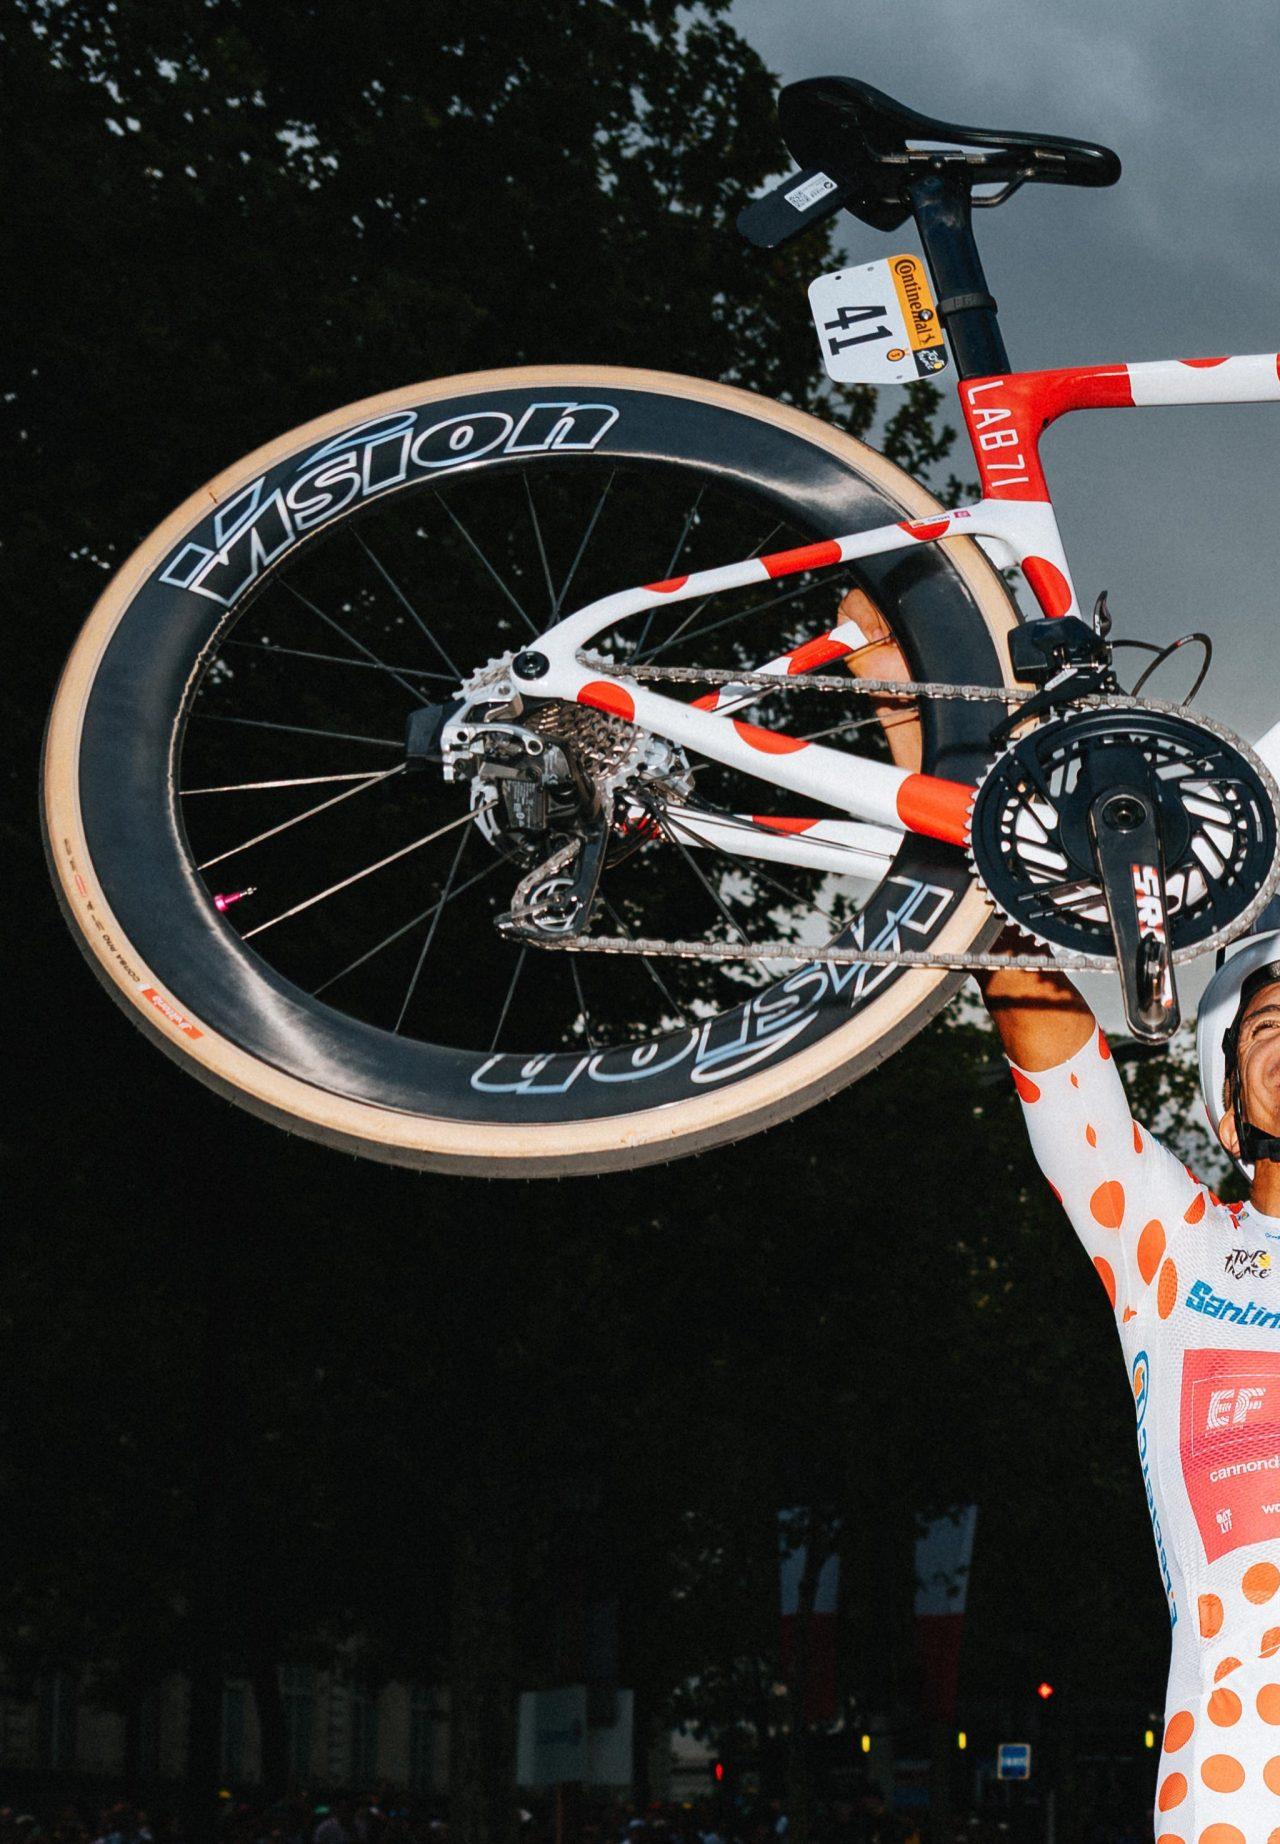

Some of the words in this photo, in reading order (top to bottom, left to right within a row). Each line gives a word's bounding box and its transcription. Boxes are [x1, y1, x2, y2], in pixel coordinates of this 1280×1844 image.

[823, 305, 894, 357] 41
[967, 380, 1030, 488] LAB71
[1206, 1386, 1267, 1431] EF
